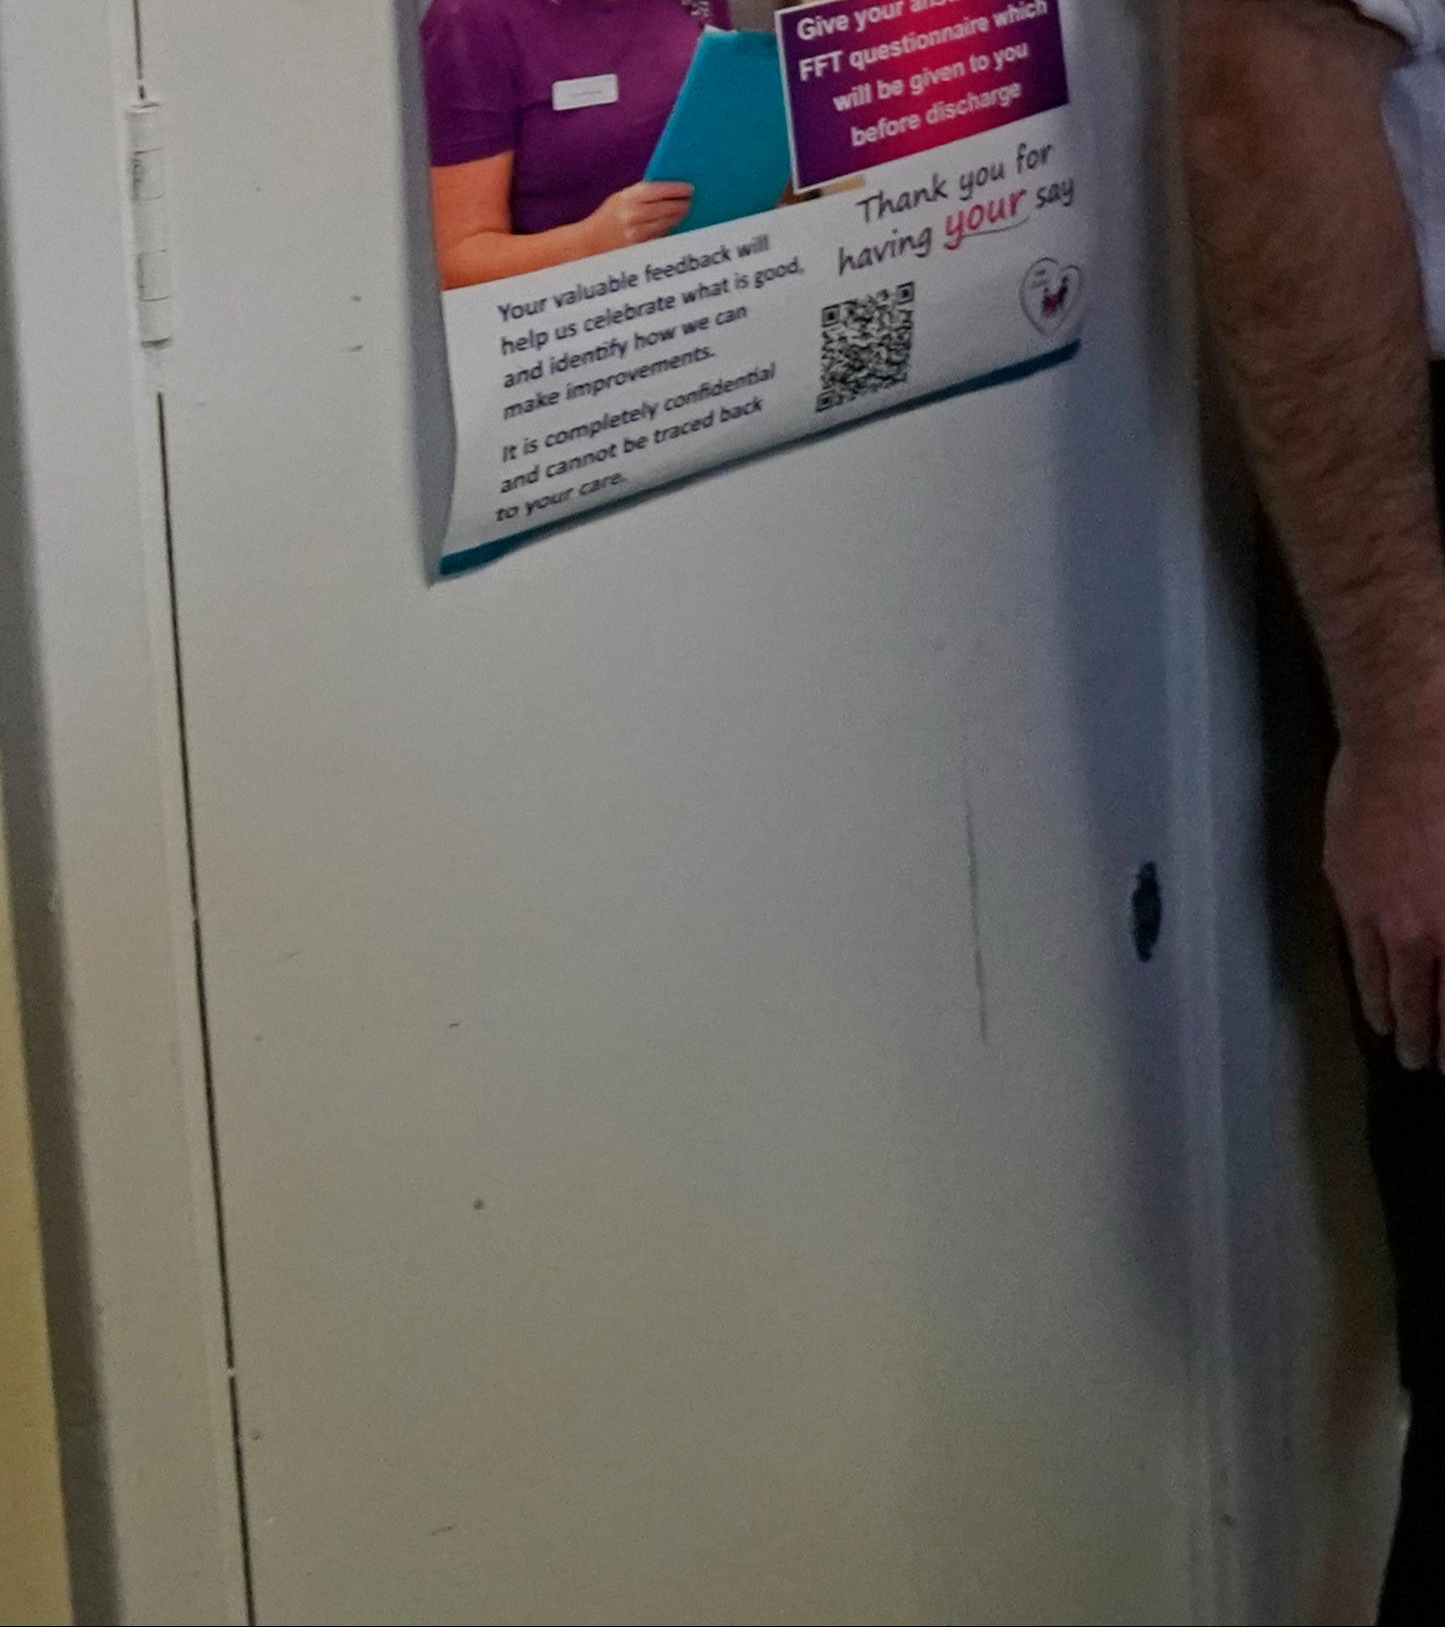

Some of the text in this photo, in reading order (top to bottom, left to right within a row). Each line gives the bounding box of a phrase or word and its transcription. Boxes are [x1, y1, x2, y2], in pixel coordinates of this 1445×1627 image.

[797, 14, 849, 41] Give
[854, 0, 904, 33] your
[798, 50, 843, 82] FFT
[849, 14, 990, 71] questionnaire
[832, 41, 1029, 112] will be given to you
[850, 81, 1022, 147] before discharge
[855, 141, 1053, 224] Thank you for
[838, 176, 1074, 276] having your say
[498, 233, 770, 323] Your valuable feedback will
[501, 329, 549, 357] help
[555, 323, 577, 341] us
[582, 292, 676, 333] celebrate
[681, 276, 728, 305] what
[734, 273, 749, 291] is
[503, 305, 748, 389] and identify how we can
[503, 345, 716, 421] make improvements.
[500, 395, 764, 494] and cannot be traced back
[502, 361, 776, 463] It is completely confidential
[495, 505, 519, 523] to
[525, 486, 573, 517] your
